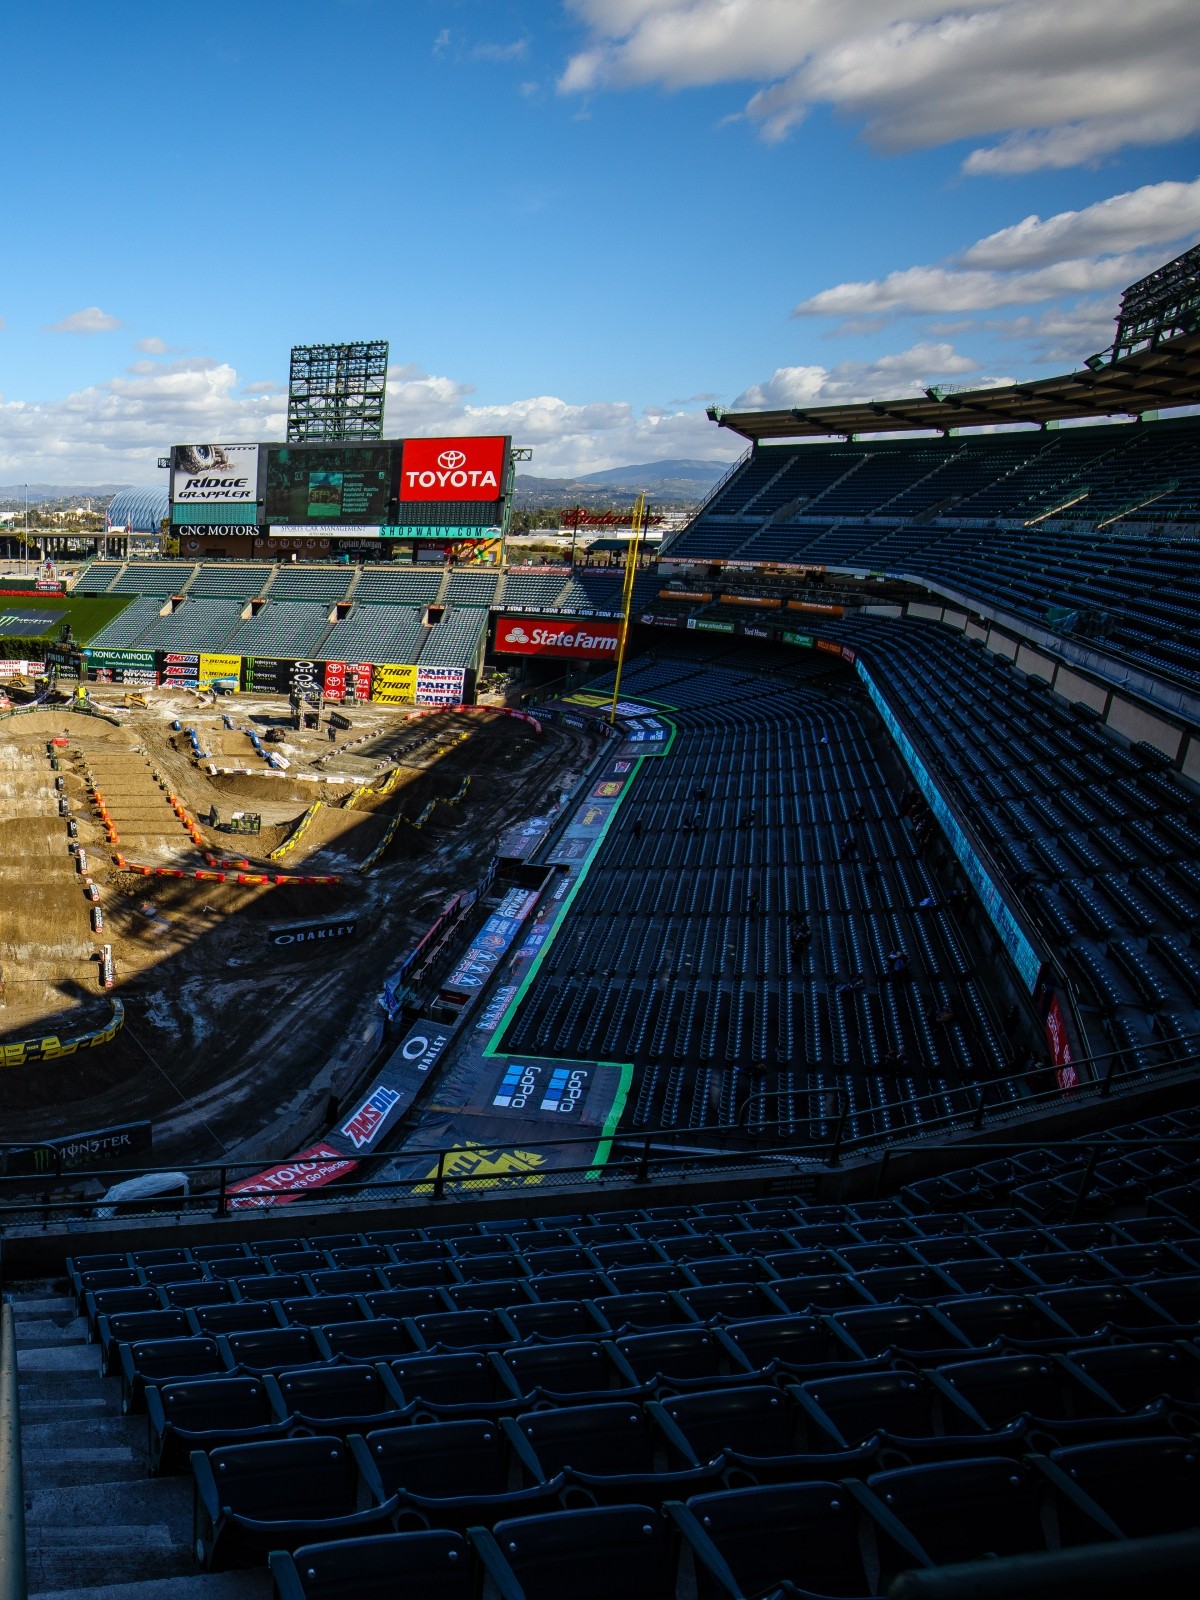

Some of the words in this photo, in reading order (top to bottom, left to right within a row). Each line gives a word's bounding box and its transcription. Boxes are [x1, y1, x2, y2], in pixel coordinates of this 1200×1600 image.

[184, 476, 249, 490] RIDGE
[406, 470, 497, 488] TOYOTA
[178, 490, 251, 499] GRAPPLER
[179, 525, 207, 536] CNC
[208, 525, 260, 536] MOTORS
[338, 540, 359, 549] Captain
[360, 539, 382, 549] Morgan
[744, 627, 756, 635] Yard
[755, 628, 768, 637] House
[530, 629, 573, 647] State
[574, 632, 618, 650] Farm
[47, 653, 65, 663] FINISH
[93, 650, 120, 659] KONICA
[121, 652, 153, 660] MINOLTA
[165, 654, 199, 663] AMSOIL
[165, 666, 198, 675] AMSOIL
[383, 668, 412, 676] THOR
[418, 668, 463, 676] PARTS
[416, 695, 461, 703] PARTS
[296, 926, 354, 942] OAKLEY
[417, 1035, 448, 1071] OAKLEY
[511, 1066, 542, 1109] GoPro
[559, 1070, 588, 1112] GoPro
[343, 1088, 400, 1145] AMSOIL
[53, 1133, 132, 1160] MONSTER
[265, 1150, 339, 1186] TOYOTA
[306, 1167, 321, 1182] Go
[320, 1159, 350, 1178] Places
